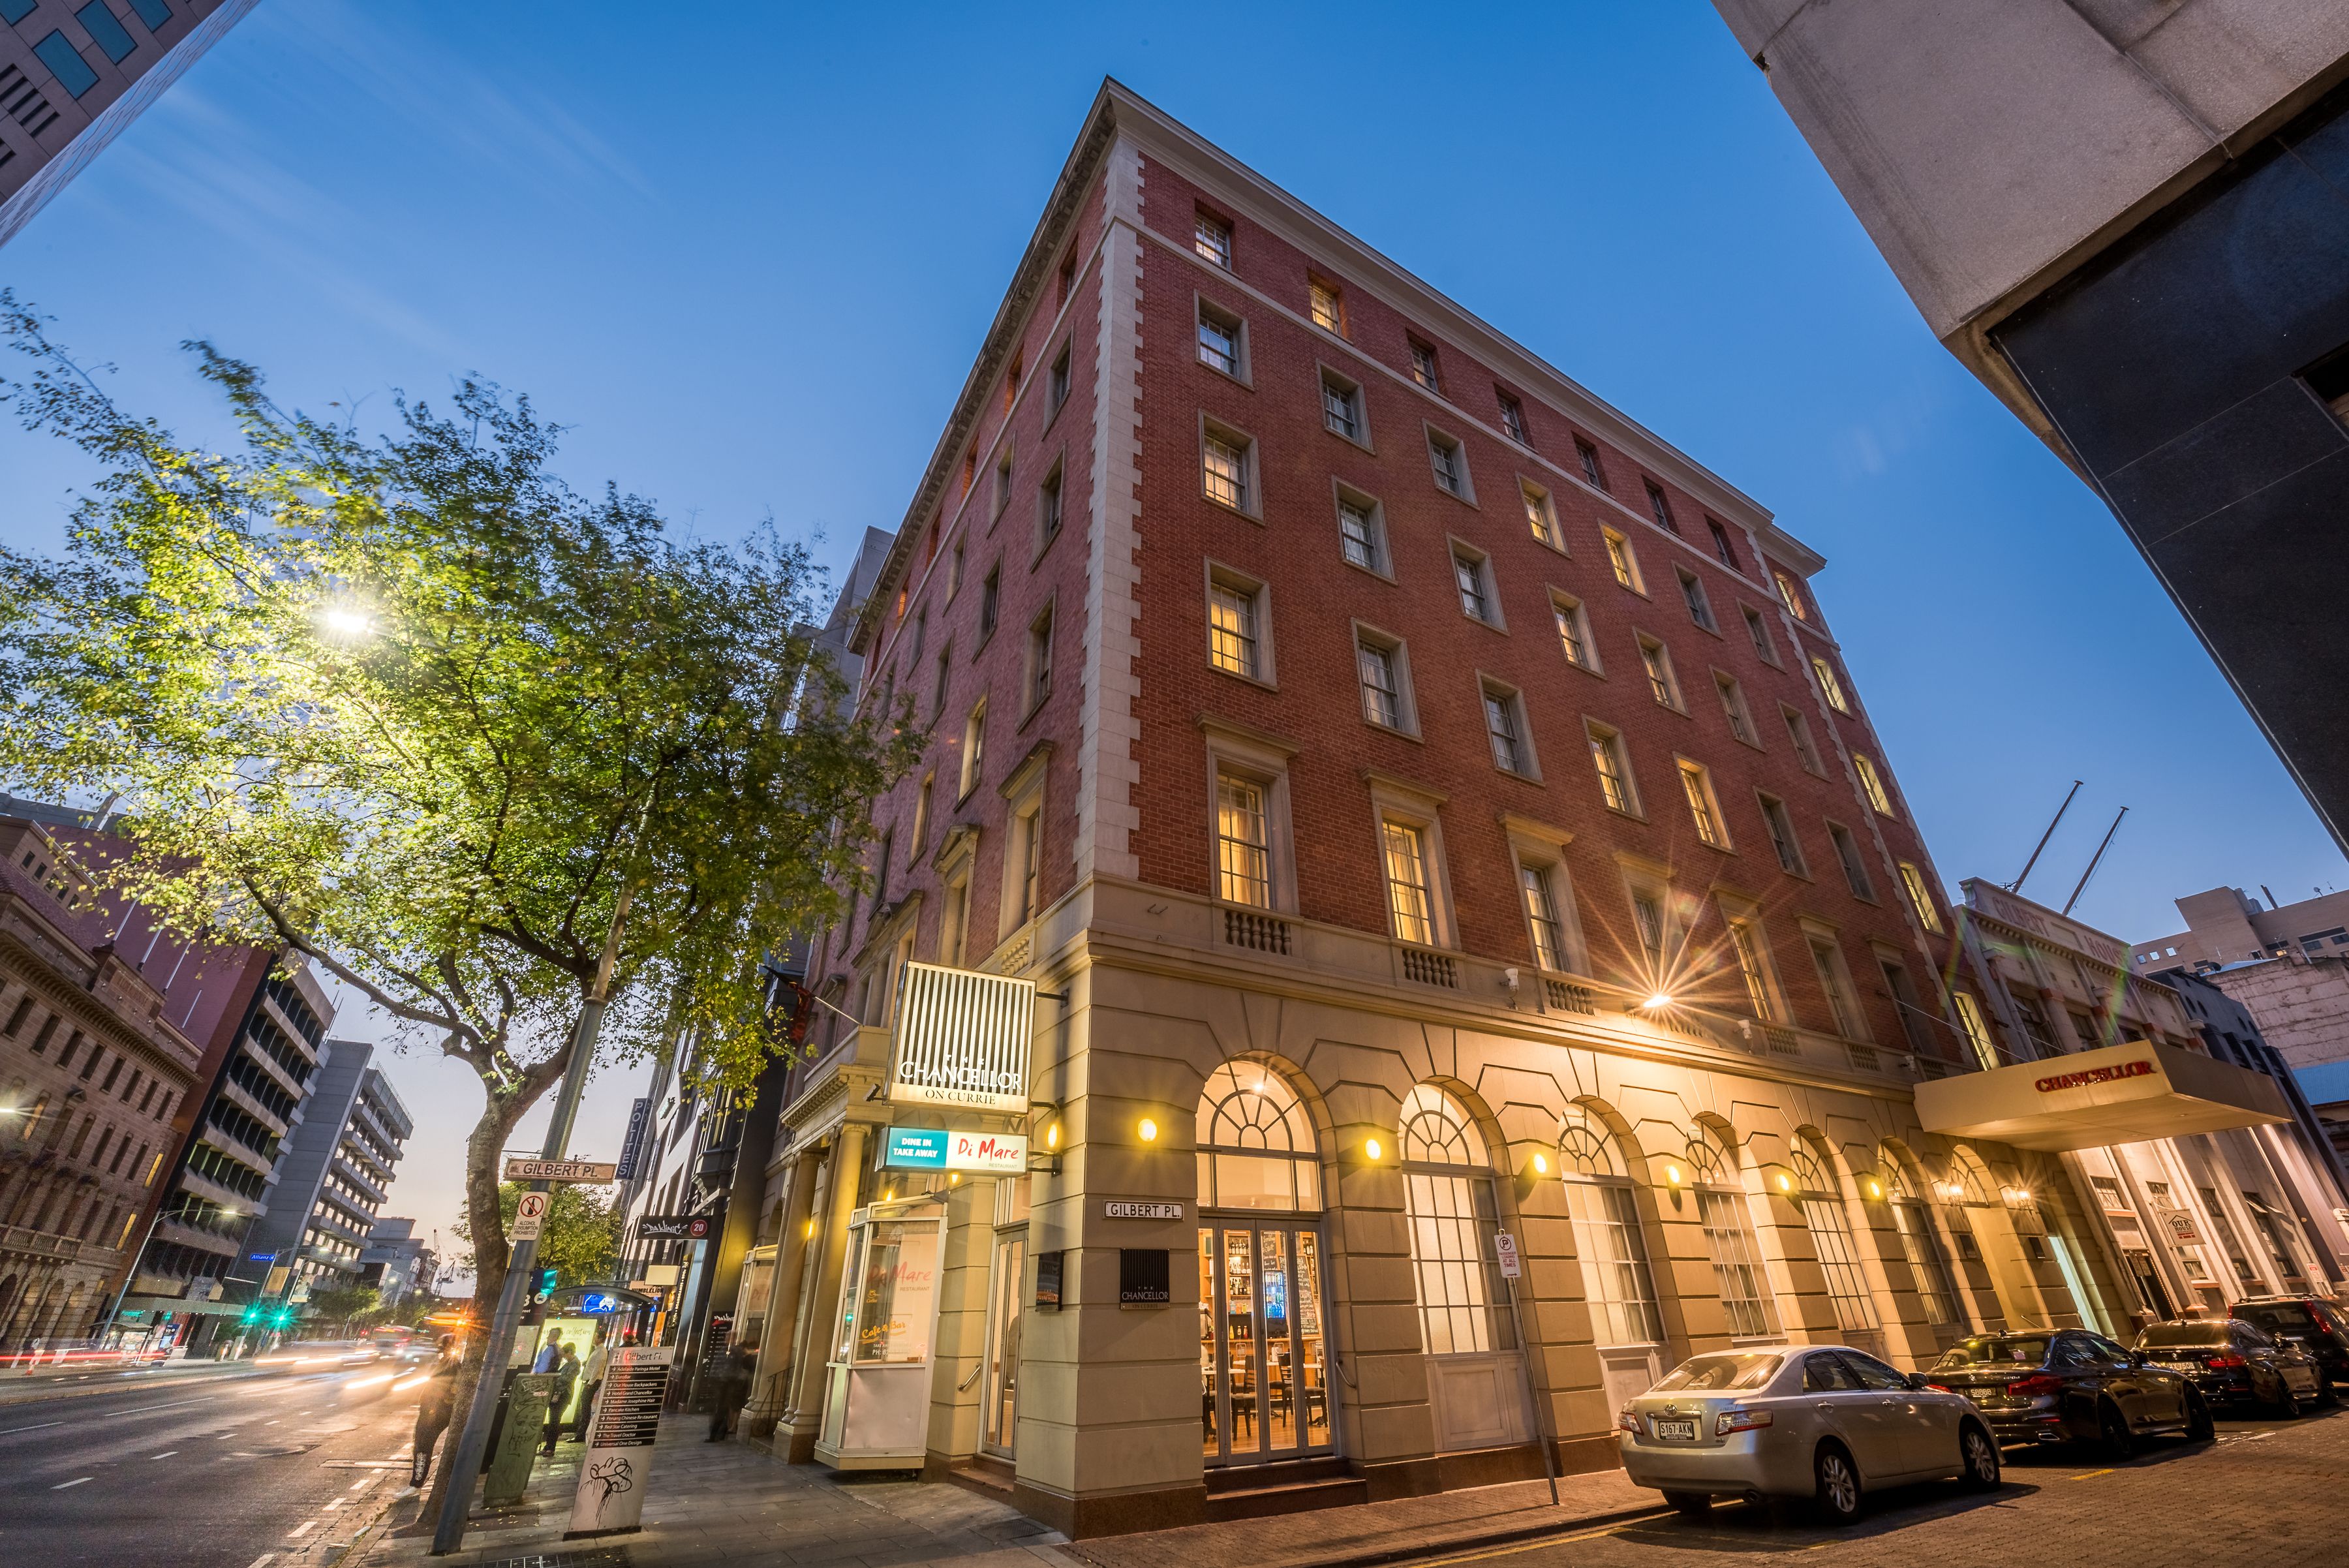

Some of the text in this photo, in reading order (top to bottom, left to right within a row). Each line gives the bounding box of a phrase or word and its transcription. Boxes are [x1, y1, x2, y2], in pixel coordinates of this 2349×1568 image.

[1992, 897, 2050, 937] GILBERT
[945, 1054, 985, 1066] THE
[899, 1061, 1022, 1090] CHANCELLOR
[2034, 1061, 2157, 1092] CHANCELLOR
[925, 1089, 996, 1105] ON CURRIE
[619, 1101, 643, 1175] POLITES
[901, 1137, 921, 1146] DINE
[893, 1148, 938, 1158] TAKE AWAY
[958, 1138, 1019, 1161] Di Mare
[523, 1163, 597, 1177] GILBERT PL
[1111, 1204, 1180, 1217] GILBERT PL.
[694, 1223, 704, 1232] 20
[889, 1261, 931, 1284] Mare
[1122, 1291, 1169, 1300] CHANCELLOR
[861, 1325, 882, 1338] Cafe
[891, 1320, 906, 1329] Bar
[626, 1352, 652, 1361] Gilbert
